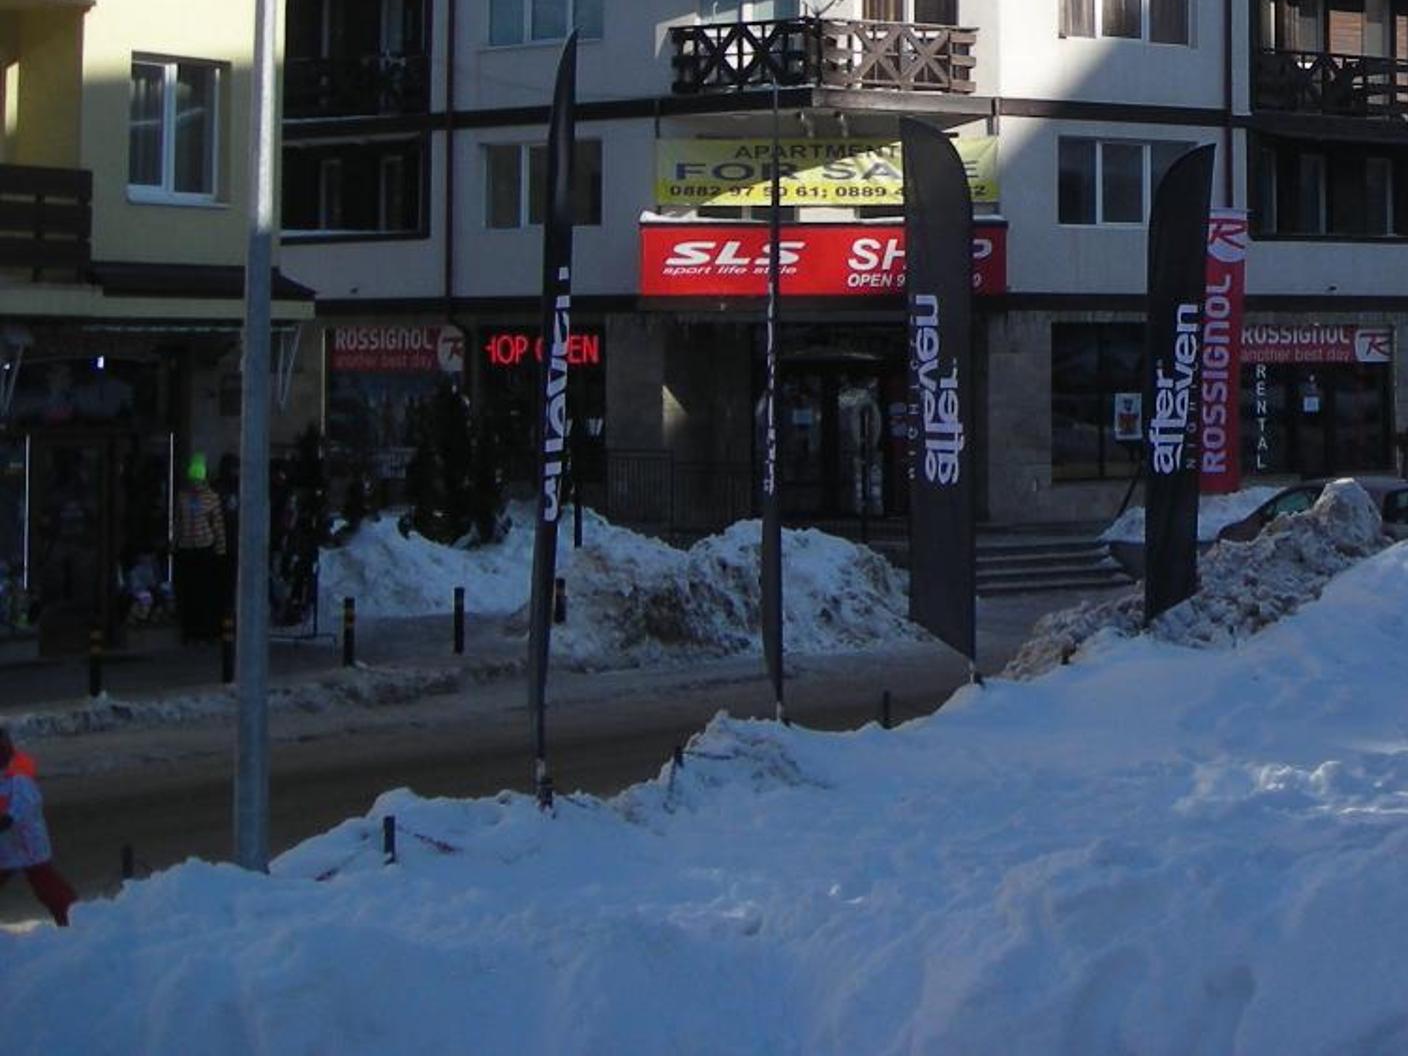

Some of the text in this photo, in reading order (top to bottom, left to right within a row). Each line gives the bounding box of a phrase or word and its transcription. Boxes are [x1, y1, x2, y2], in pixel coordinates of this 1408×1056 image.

[675, 162, 980, 180] FOR SAE
[670, 185, 725, 198] 0882
[730, 185, 755, 198] 97
[834, 185, 888, 198] 0889
[664, 238, 993, 271] SLS SHP
[663, 265, 797, 277] sport life stle
[848, 273, 893, 288] OPEN
[335, 327, 435, 351] ROSSIGNOL
[1241, 326, 1350, 345] ROSSIGNOL
[1295, 348, 1323, 361] best
[1327, 348, 1350, 363] day
[1201, 274, 1232, 474] ROSSIGNOL
[1255, 364, 1268, 469] RENTAL
